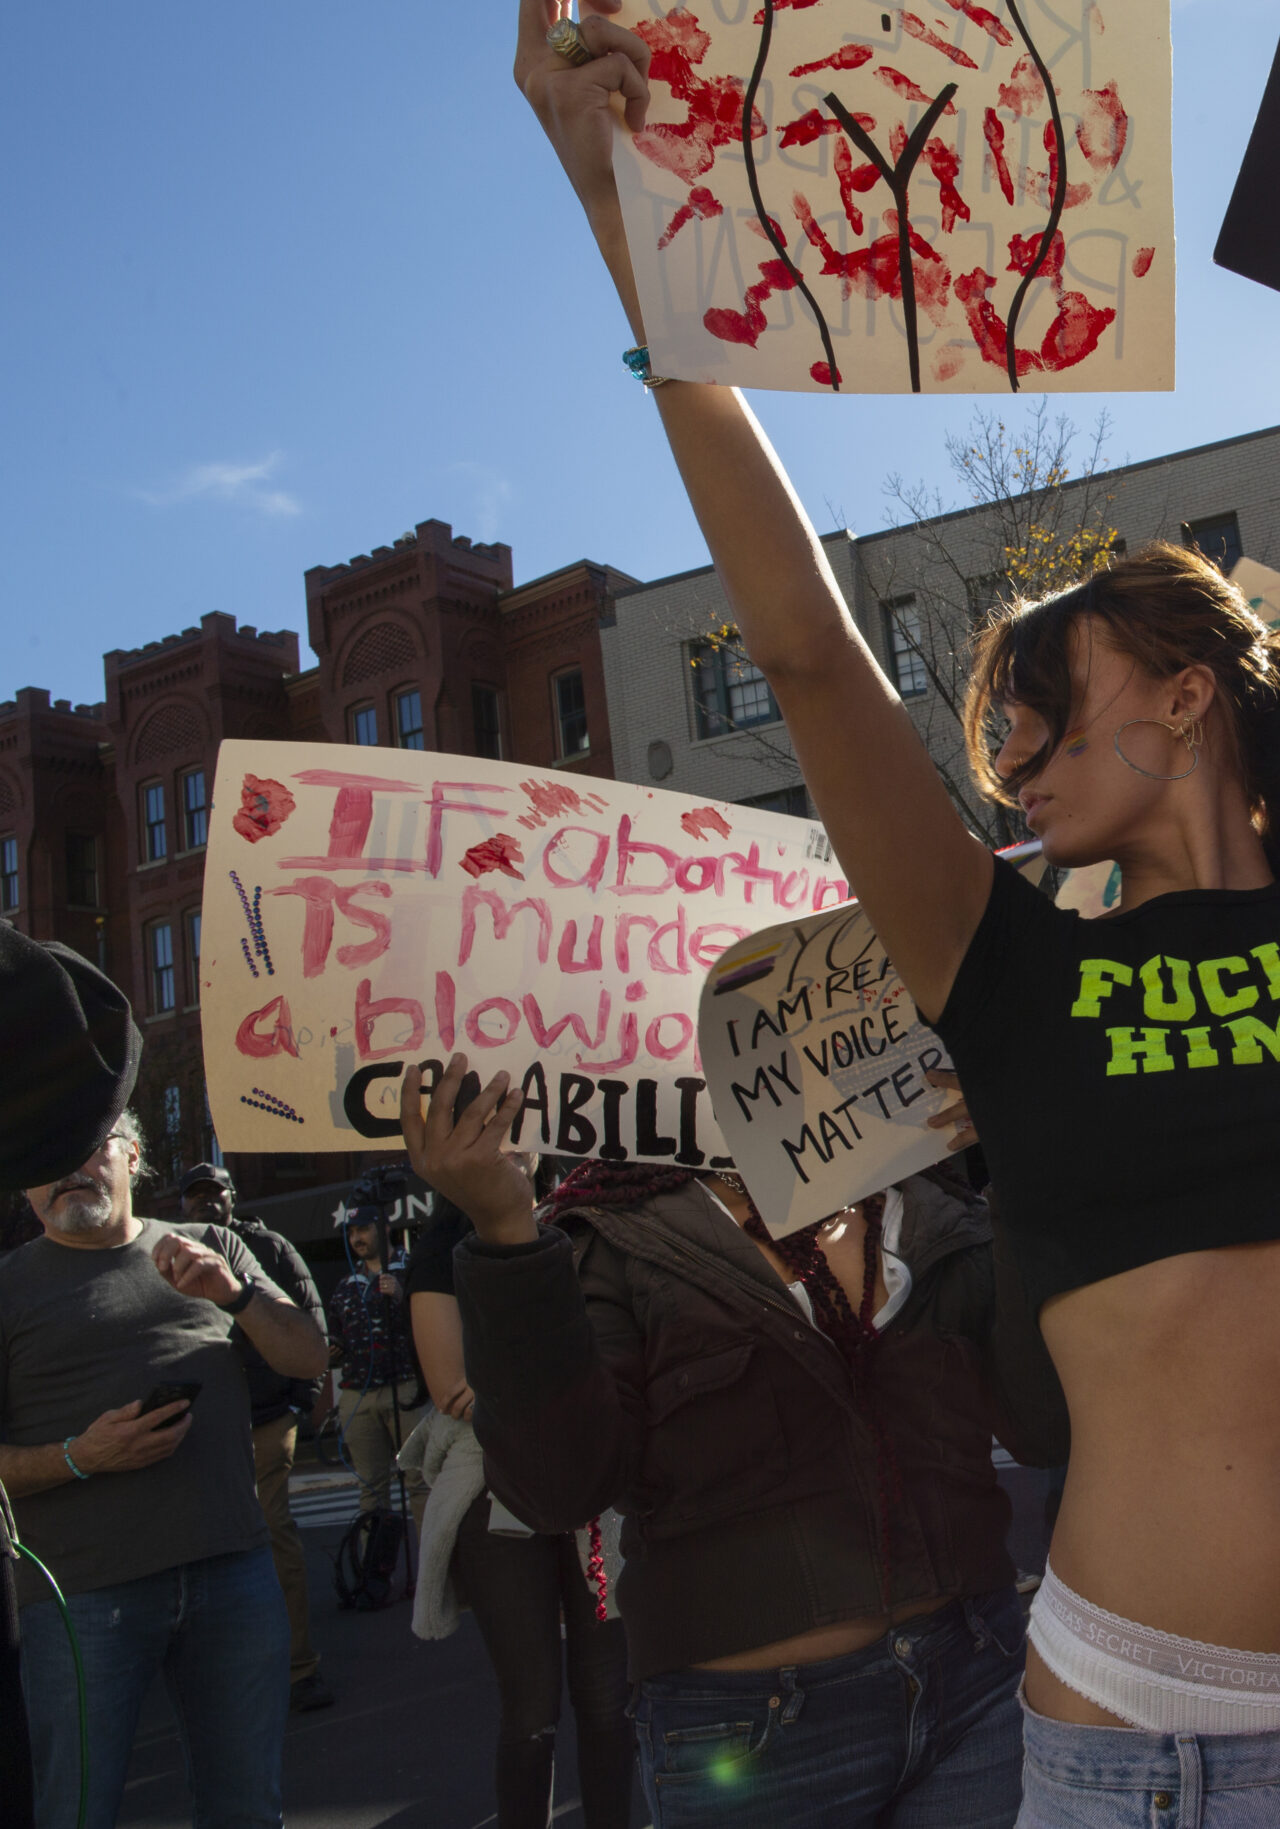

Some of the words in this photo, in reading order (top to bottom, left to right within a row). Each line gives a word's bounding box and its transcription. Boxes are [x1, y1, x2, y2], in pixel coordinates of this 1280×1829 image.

[277, 769, 514, 879] IF
[542, 814, 851, 911] abortion
[458, 883, 751, 974] murde
[235, 994, 301, 1059] a
[355, 971, 700, 1074] blowjo
[726, 1019, 741, 1057] I
[752, 986, 813, 1050] AM
[731, 1051, 801, 1123] MY
[803, 1004, 908, 1078] VOICE
[1085, 1621, 1160, 1666] SECRET
